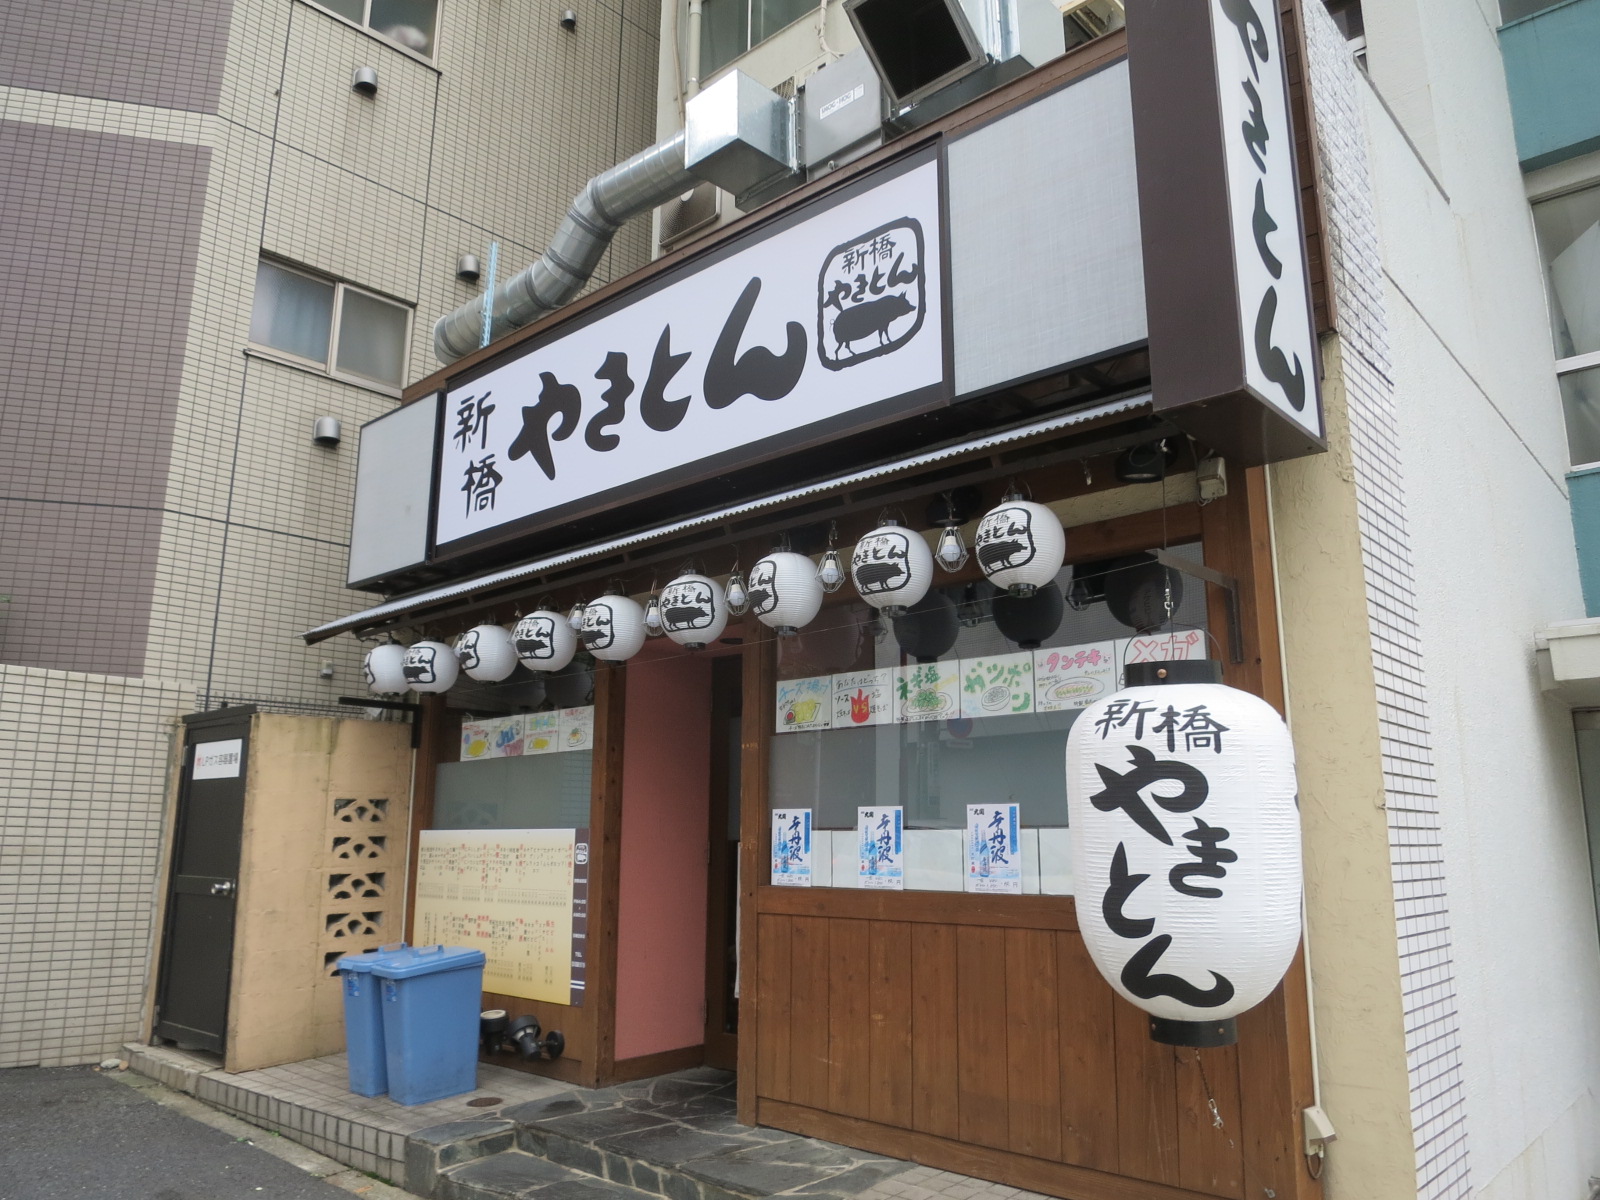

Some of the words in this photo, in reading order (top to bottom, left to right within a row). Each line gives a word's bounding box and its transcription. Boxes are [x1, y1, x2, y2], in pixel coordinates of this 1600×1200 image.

[841, 233, 897, 275] 新橋
[823, 251, 919, 312] やきとん
[508, 276, 808, 481] やきとん
[453, 390, 503, 519] 新橋
[976, 521, 1028, 547] やきとん
[852, 544, 906, 567] やきとん
[661, 591, 711, 608] やきとん
[1046, 648, 1102, 673] タンテキ
[852, 702, 868, 713] VS
[1095, 699, 1230, 754] 新橋
[196, 752, 239, 767] LPガス容器置場
[1089, 744, 1239, 1008] やきとん
